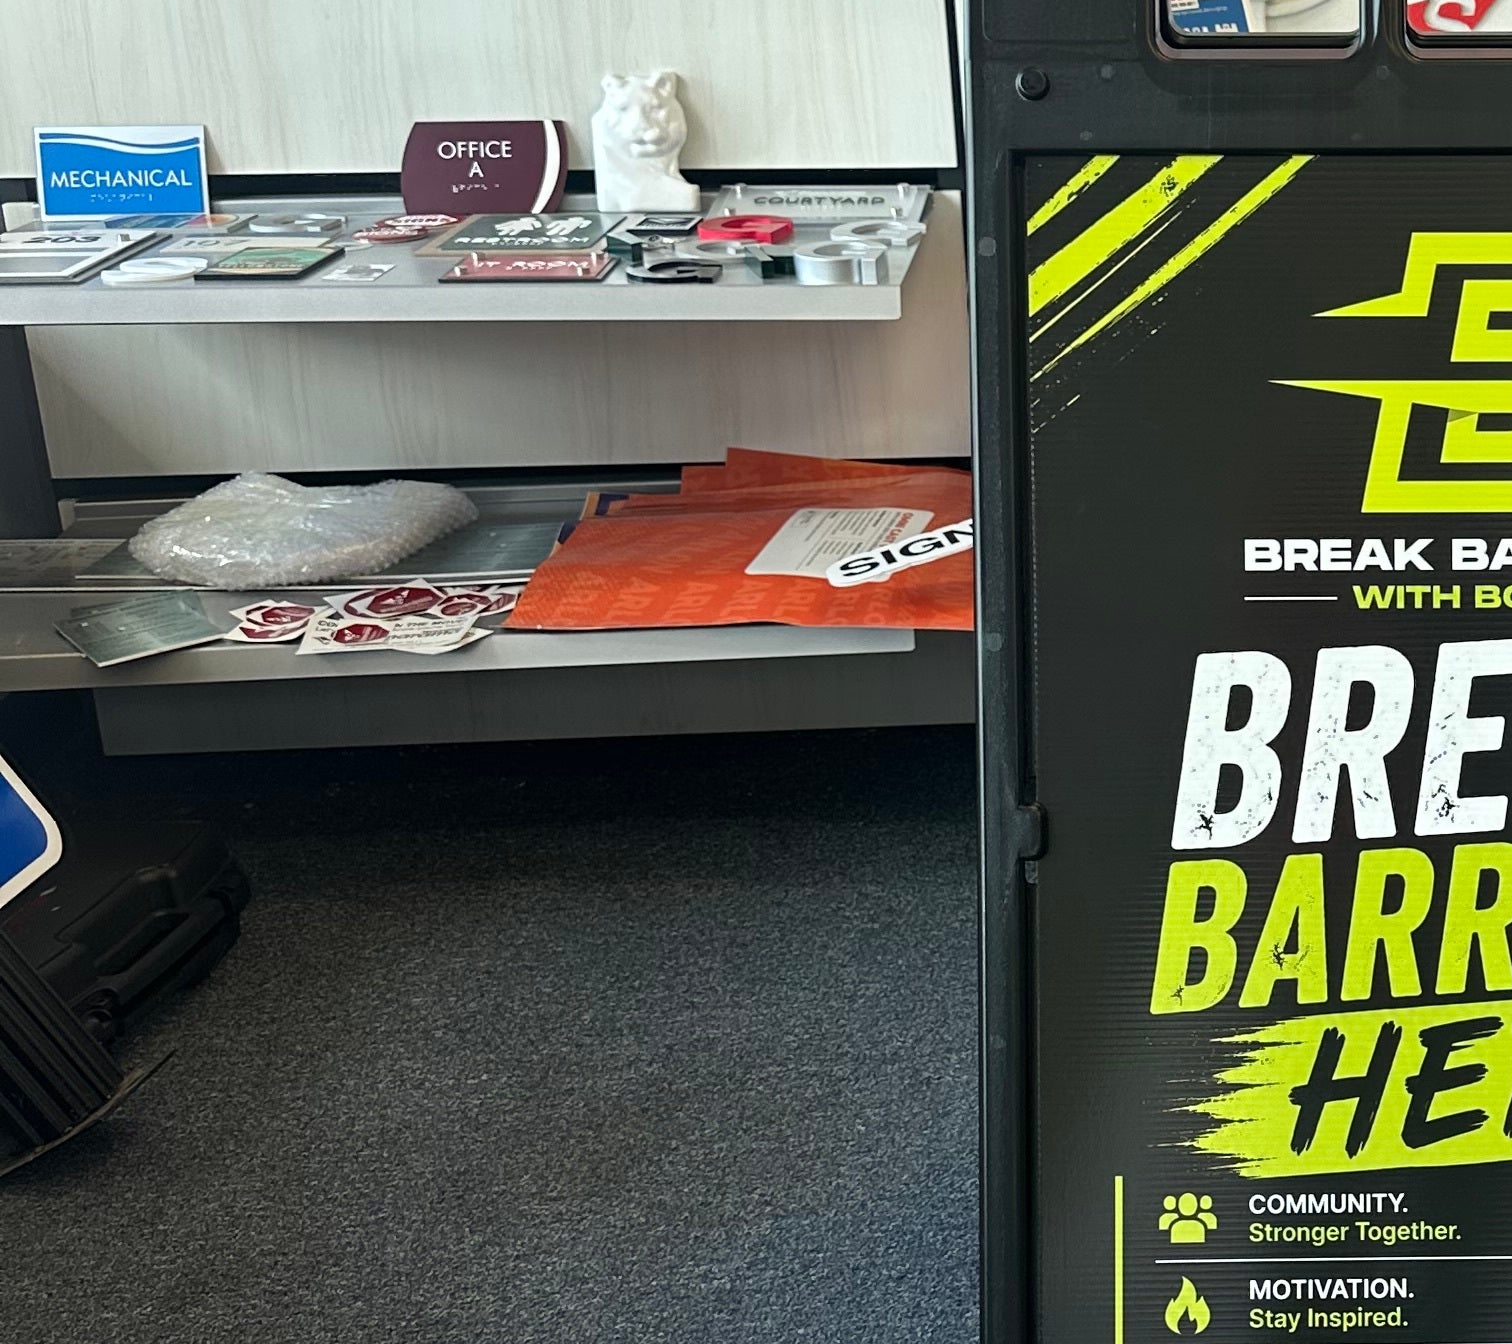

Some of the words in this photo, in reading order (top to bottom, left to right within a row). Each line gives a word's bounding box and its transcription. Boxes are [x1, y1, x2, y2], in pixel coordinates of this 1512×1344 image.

[437, 140, 512, 160] OFFICE
[50, 168, 193, 189] MECHANICAL
[468, 161, 484, 178] A
[753, 195, 886, 206] COURTYARD
[1244, 537, 1434, 572] BREAK
[1352, 584, 1461, 610] WITH
[1248, 1192, 1409, 1215] COMMUNITY.
[1248, 1222, 1350, 1247] Stronger
[1354, 1221, 1462, 1246] Together.
[1249, 1277, 1415, 1300] MOTIVATION.
[1249, 1308, 1301, 1333] Stay
[1307, 1306, 1409, 1332] Inspired.
